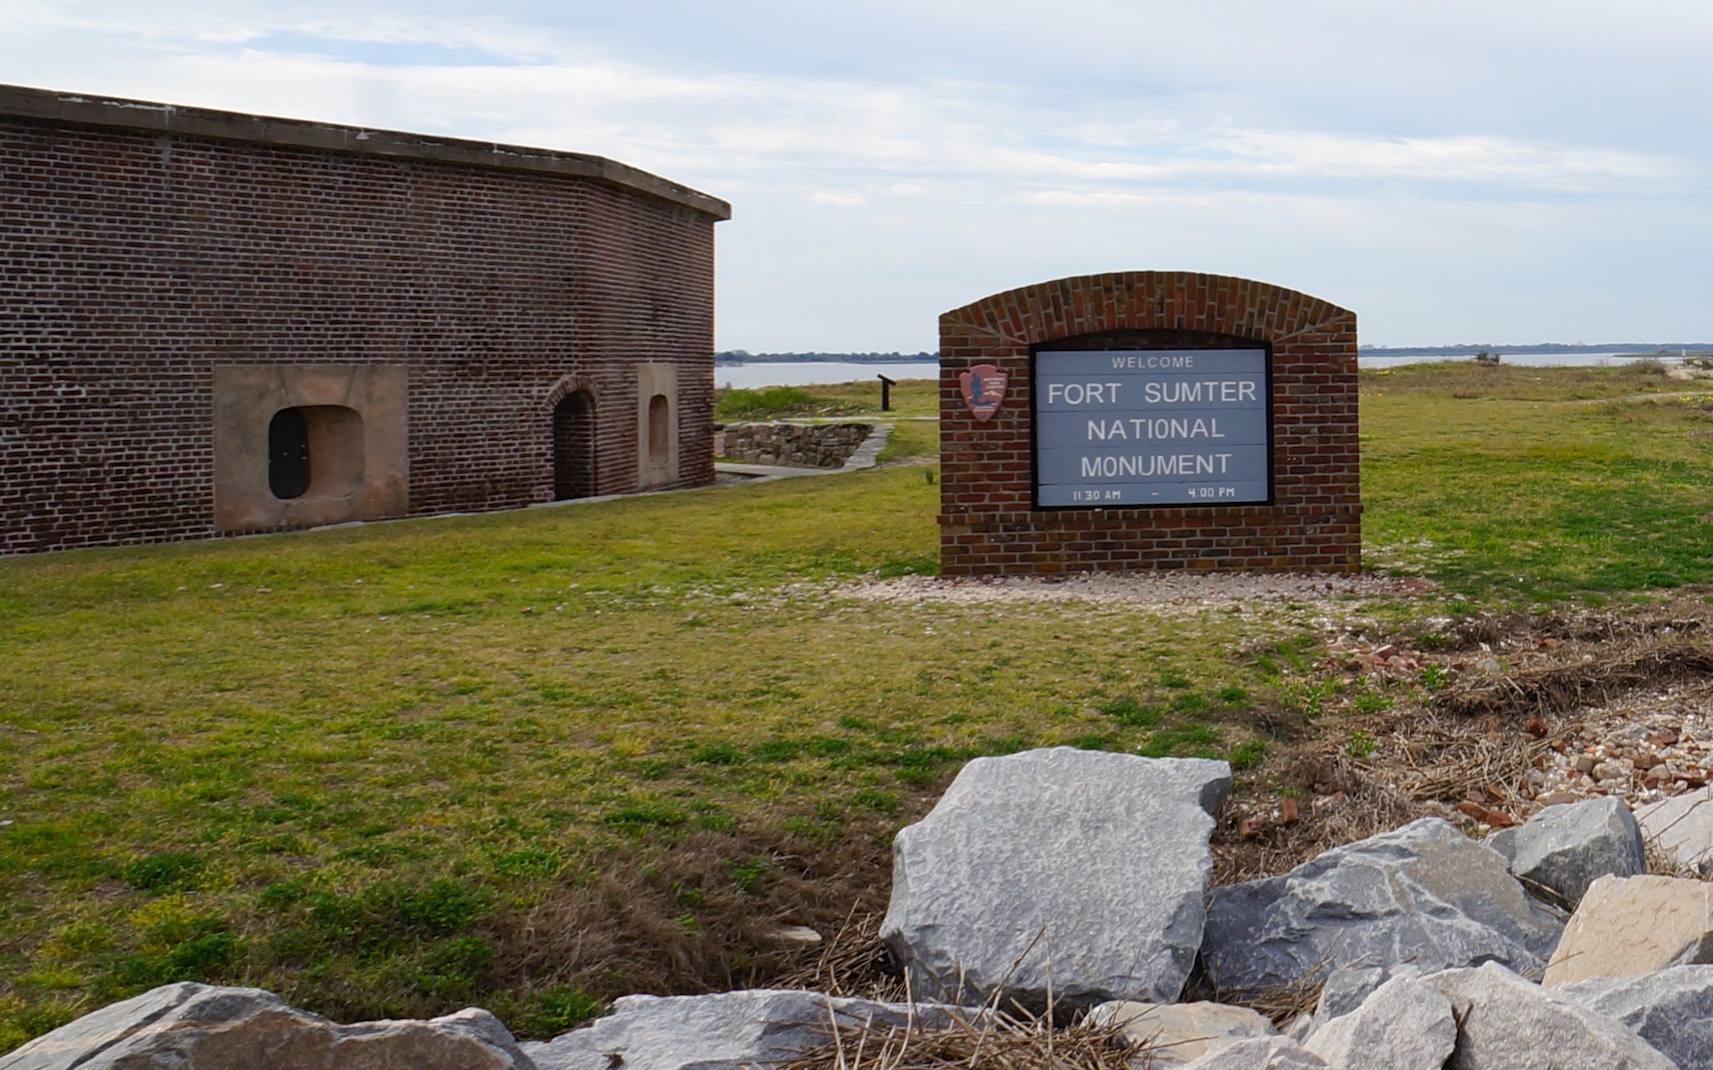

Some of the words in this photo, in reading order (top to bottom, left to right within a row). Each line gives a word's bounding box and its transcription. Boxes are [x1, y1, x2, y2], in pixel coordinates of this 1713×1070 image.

[1111, 355, 1194, 370] WELCOME
[1048, 382, 1123, 405] FORT
[1144, 380, 1257, 403] SUMTER
[1087, 417, 1225, 441] NATIONAL
[1081, 453, 1233, 478] MONUMENT
[1104, 489, 1121, 500] AM
[1218, 486, 1235, 497] PM
